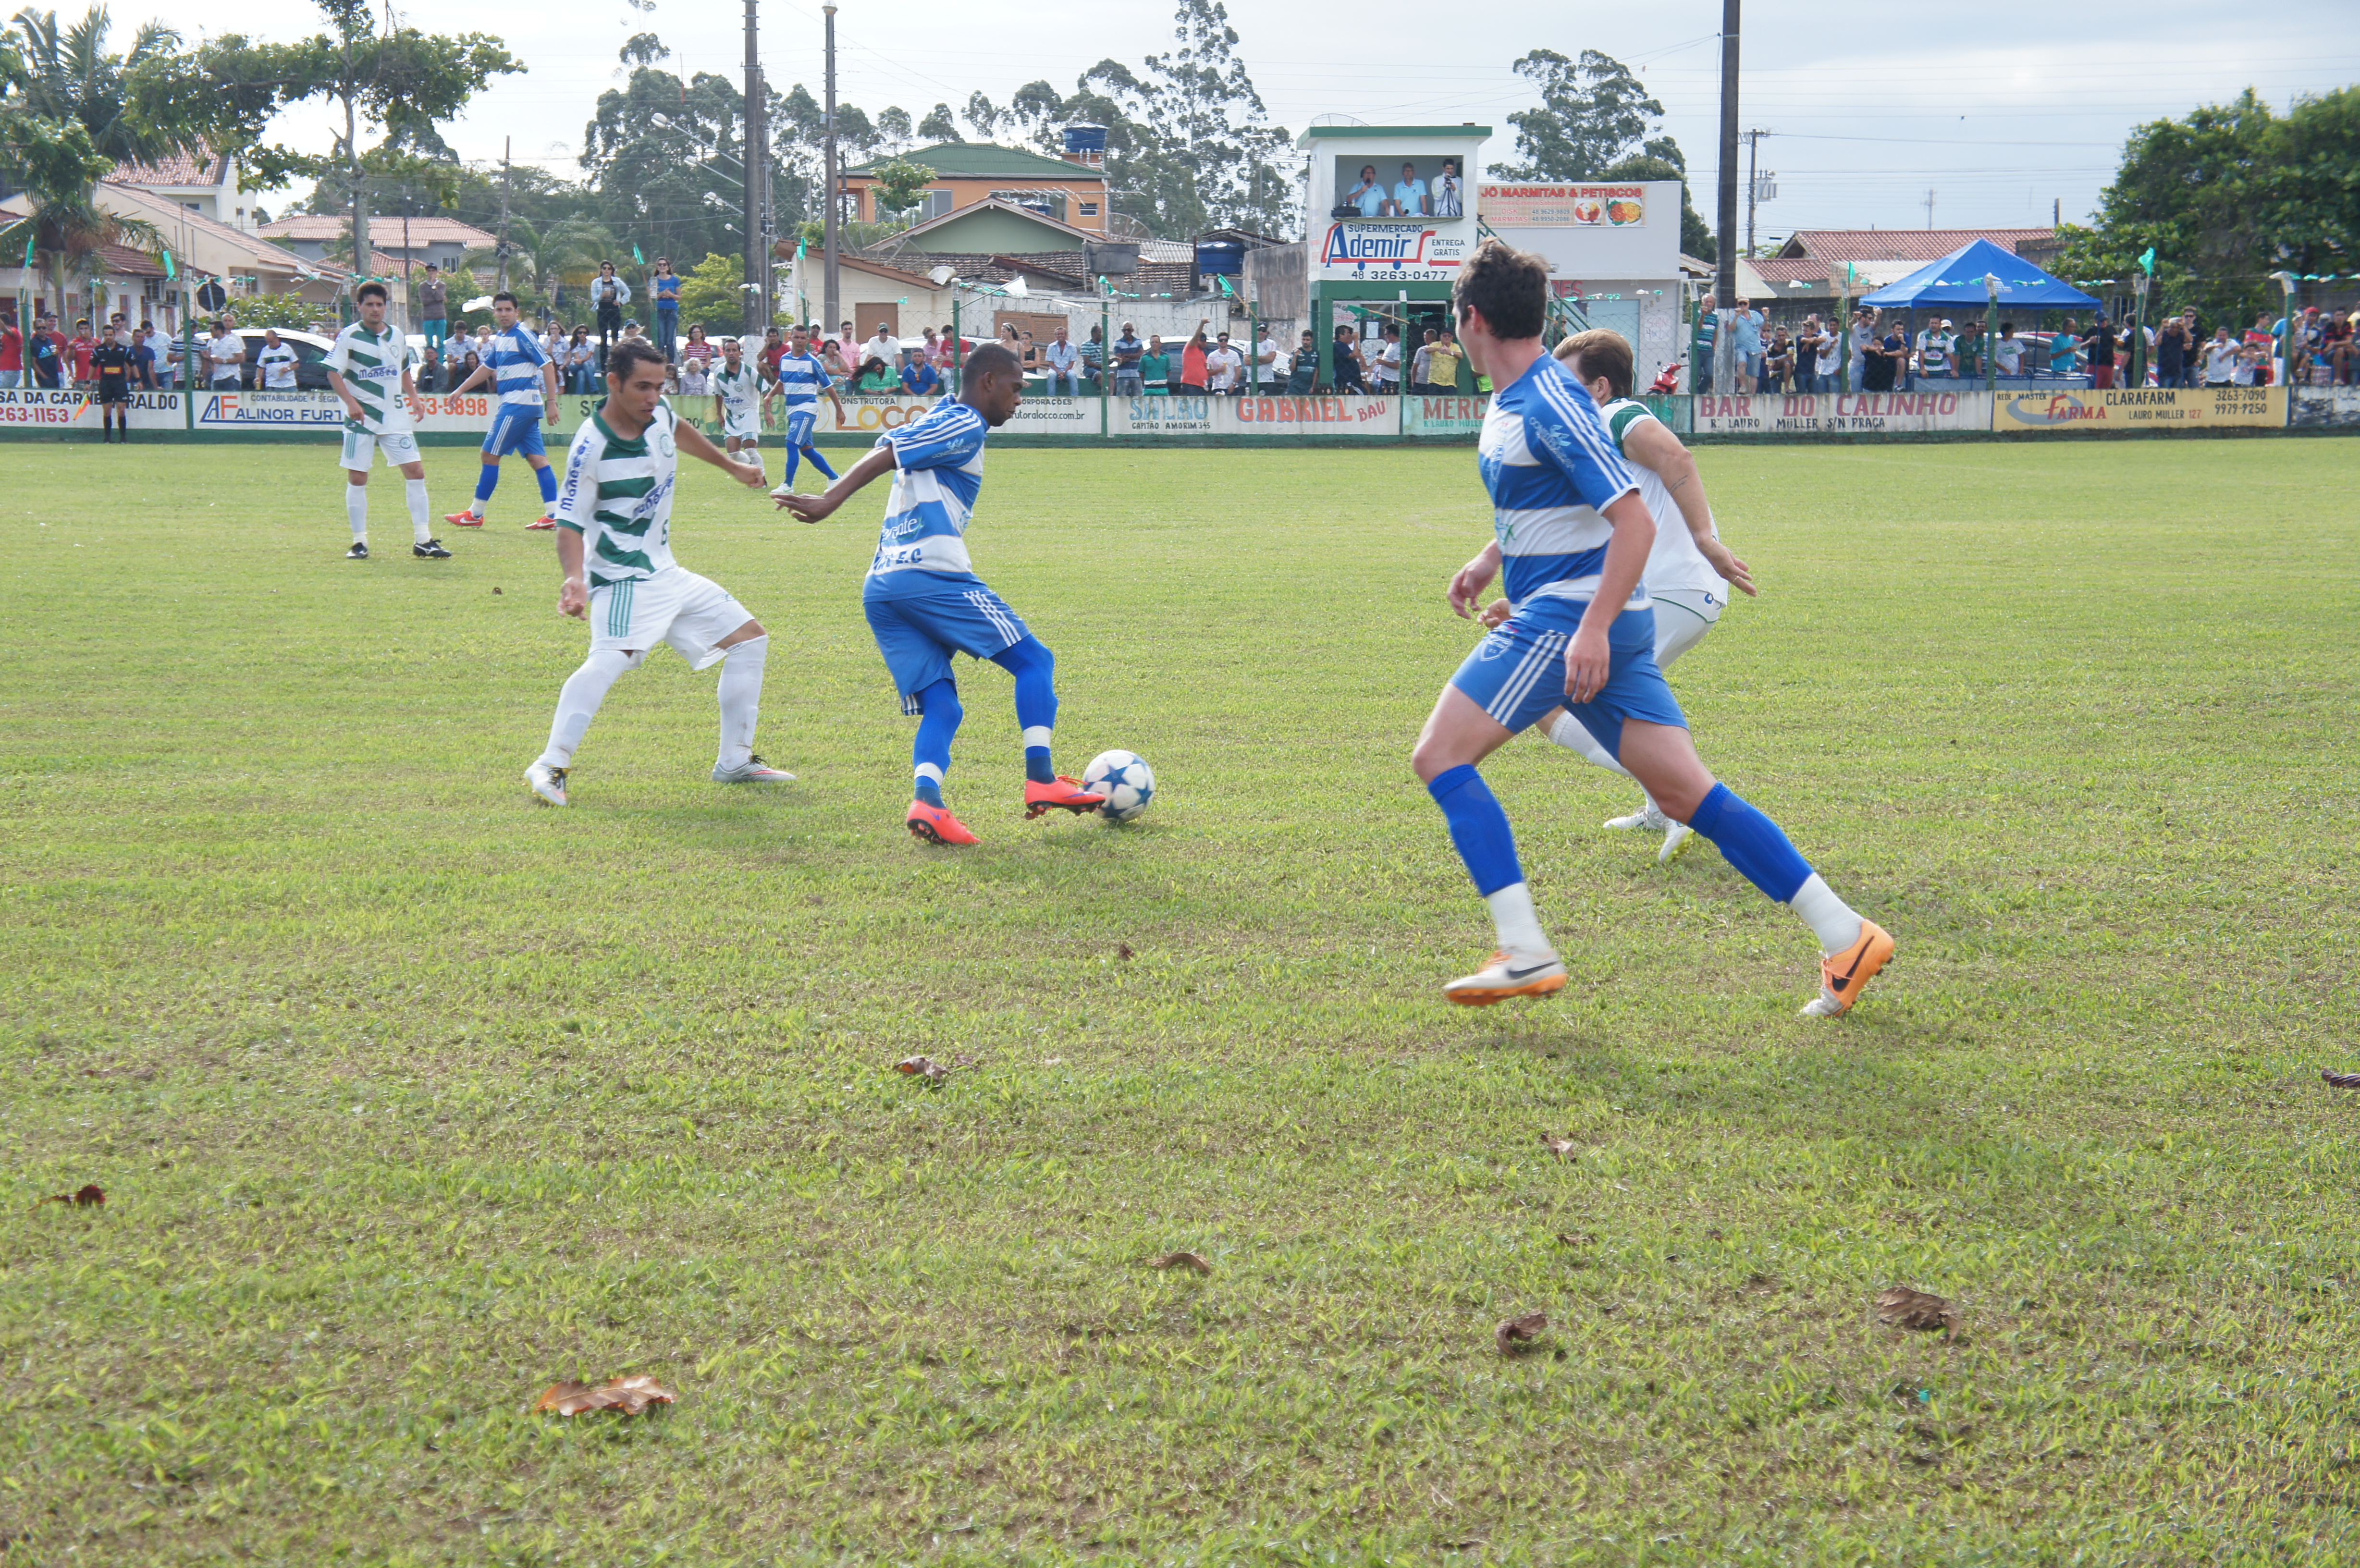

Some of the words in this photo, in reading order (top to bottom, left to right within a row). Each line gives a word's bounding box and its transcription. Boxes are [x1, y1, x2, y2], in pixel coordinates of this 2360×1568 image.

[1481, 186, 1498, 197] JÔ
[1501, 188, 1566, 198] MARMITAS
[1569, 188, 1577, 197] &
[1581, 188, 1642, 198] PETISCOS
[1348, 224, 1423, 233] SUPERMERCADO
[1325, 222, 1412, 268] Ademir
[1433, 247, 1460, 256] GRÁTIS
[1352, 271, 1364, 280] 48
[1371, 271, 1448, 280] 3263-0477
[23, 392, 45, 404] DA
[250, 394, 307, 403] CONTABILIDADE
[2106, 392, 2176, 406] CLARAFARM
[2215, 390, 2266, 401] 3263-7090
[1236, 398, 1353, 423] GABRIEL
[1356, 400, 1387, 422] BAU
[1700, 395, 1751, 417] BAR
[1783, 395, 1815, 417] DO
[1836, 394, 1957, 416] CALINHO
[2044, 393, 2107, 420] FARMA
[234, 408, 294, 420] ALINOR
[2129, 410, 2152, 420] LAURO
[2155, 410, 2185, 419] MULLER
[2188, 409, 2202, 419] 127
[1431, 419, 1454, 428] LAURO
[1729, 418, 1760, 429] LAURO
[1827, 417, 1846, 429] S/N
